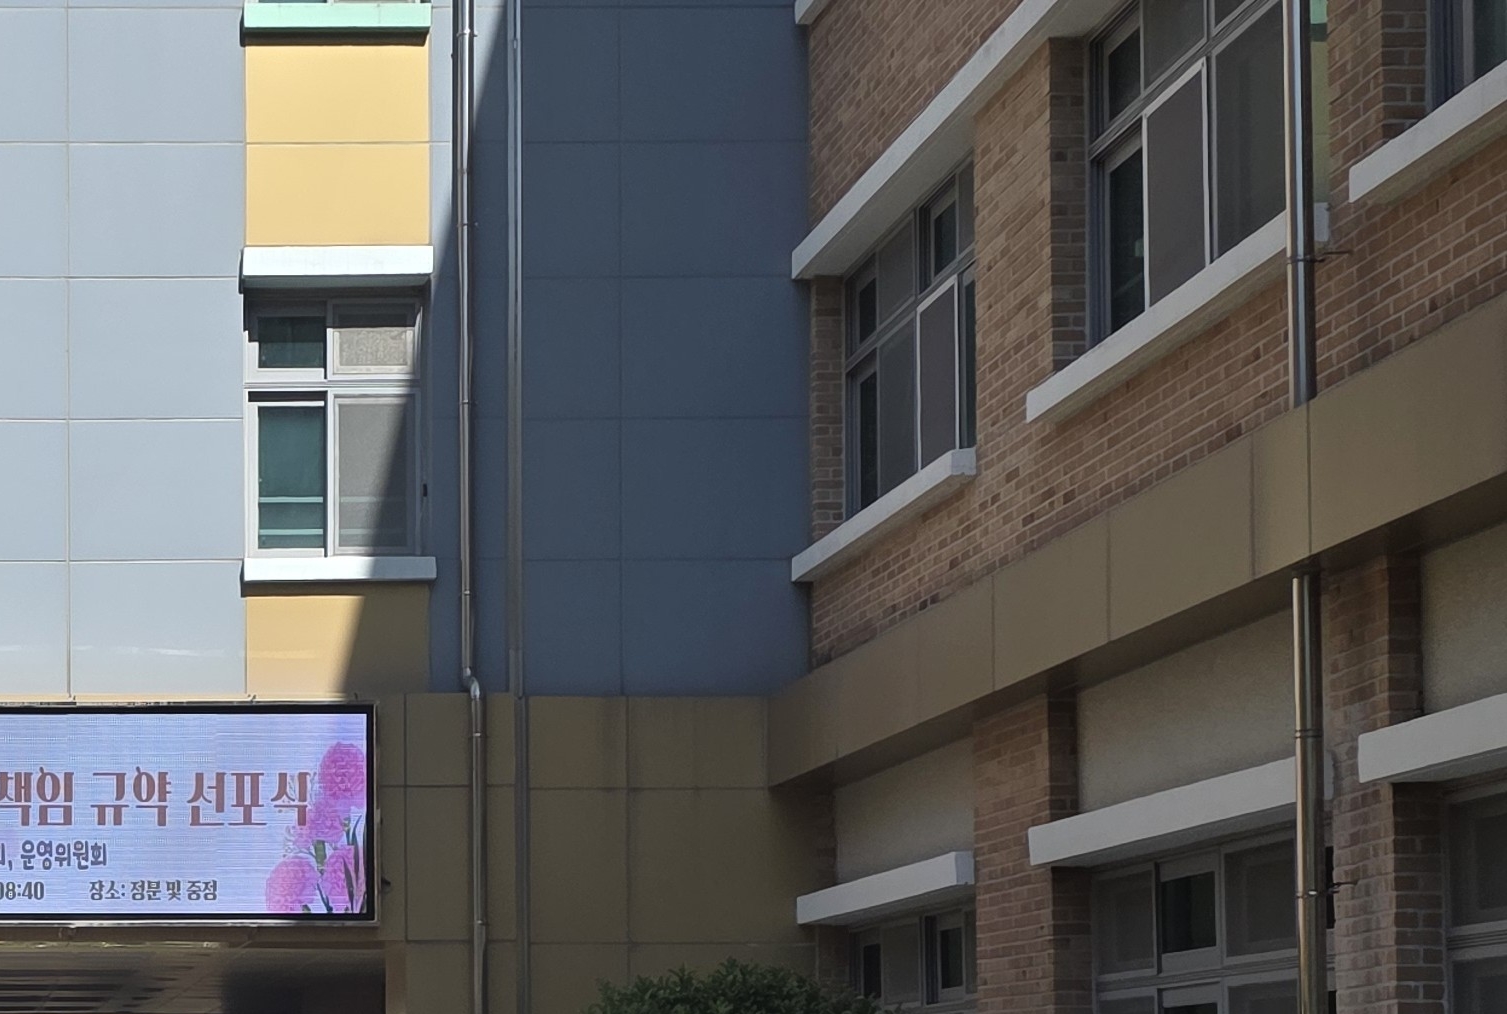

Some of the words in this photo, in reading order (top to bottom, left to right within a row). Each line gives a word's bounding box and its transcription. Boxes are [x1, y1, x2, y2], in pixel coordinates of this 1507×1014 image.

[90, 766, 172, 826] 규약
[187, 771, 312, 826] 선포식
[20, 840, 108, 870] 운영위원회
[89, 880, 125, 901] 장소:
[130, 880, 161, 901] 정문
[166, 880, 182, 901] 및
[186, 880, 218, 901] 중정
